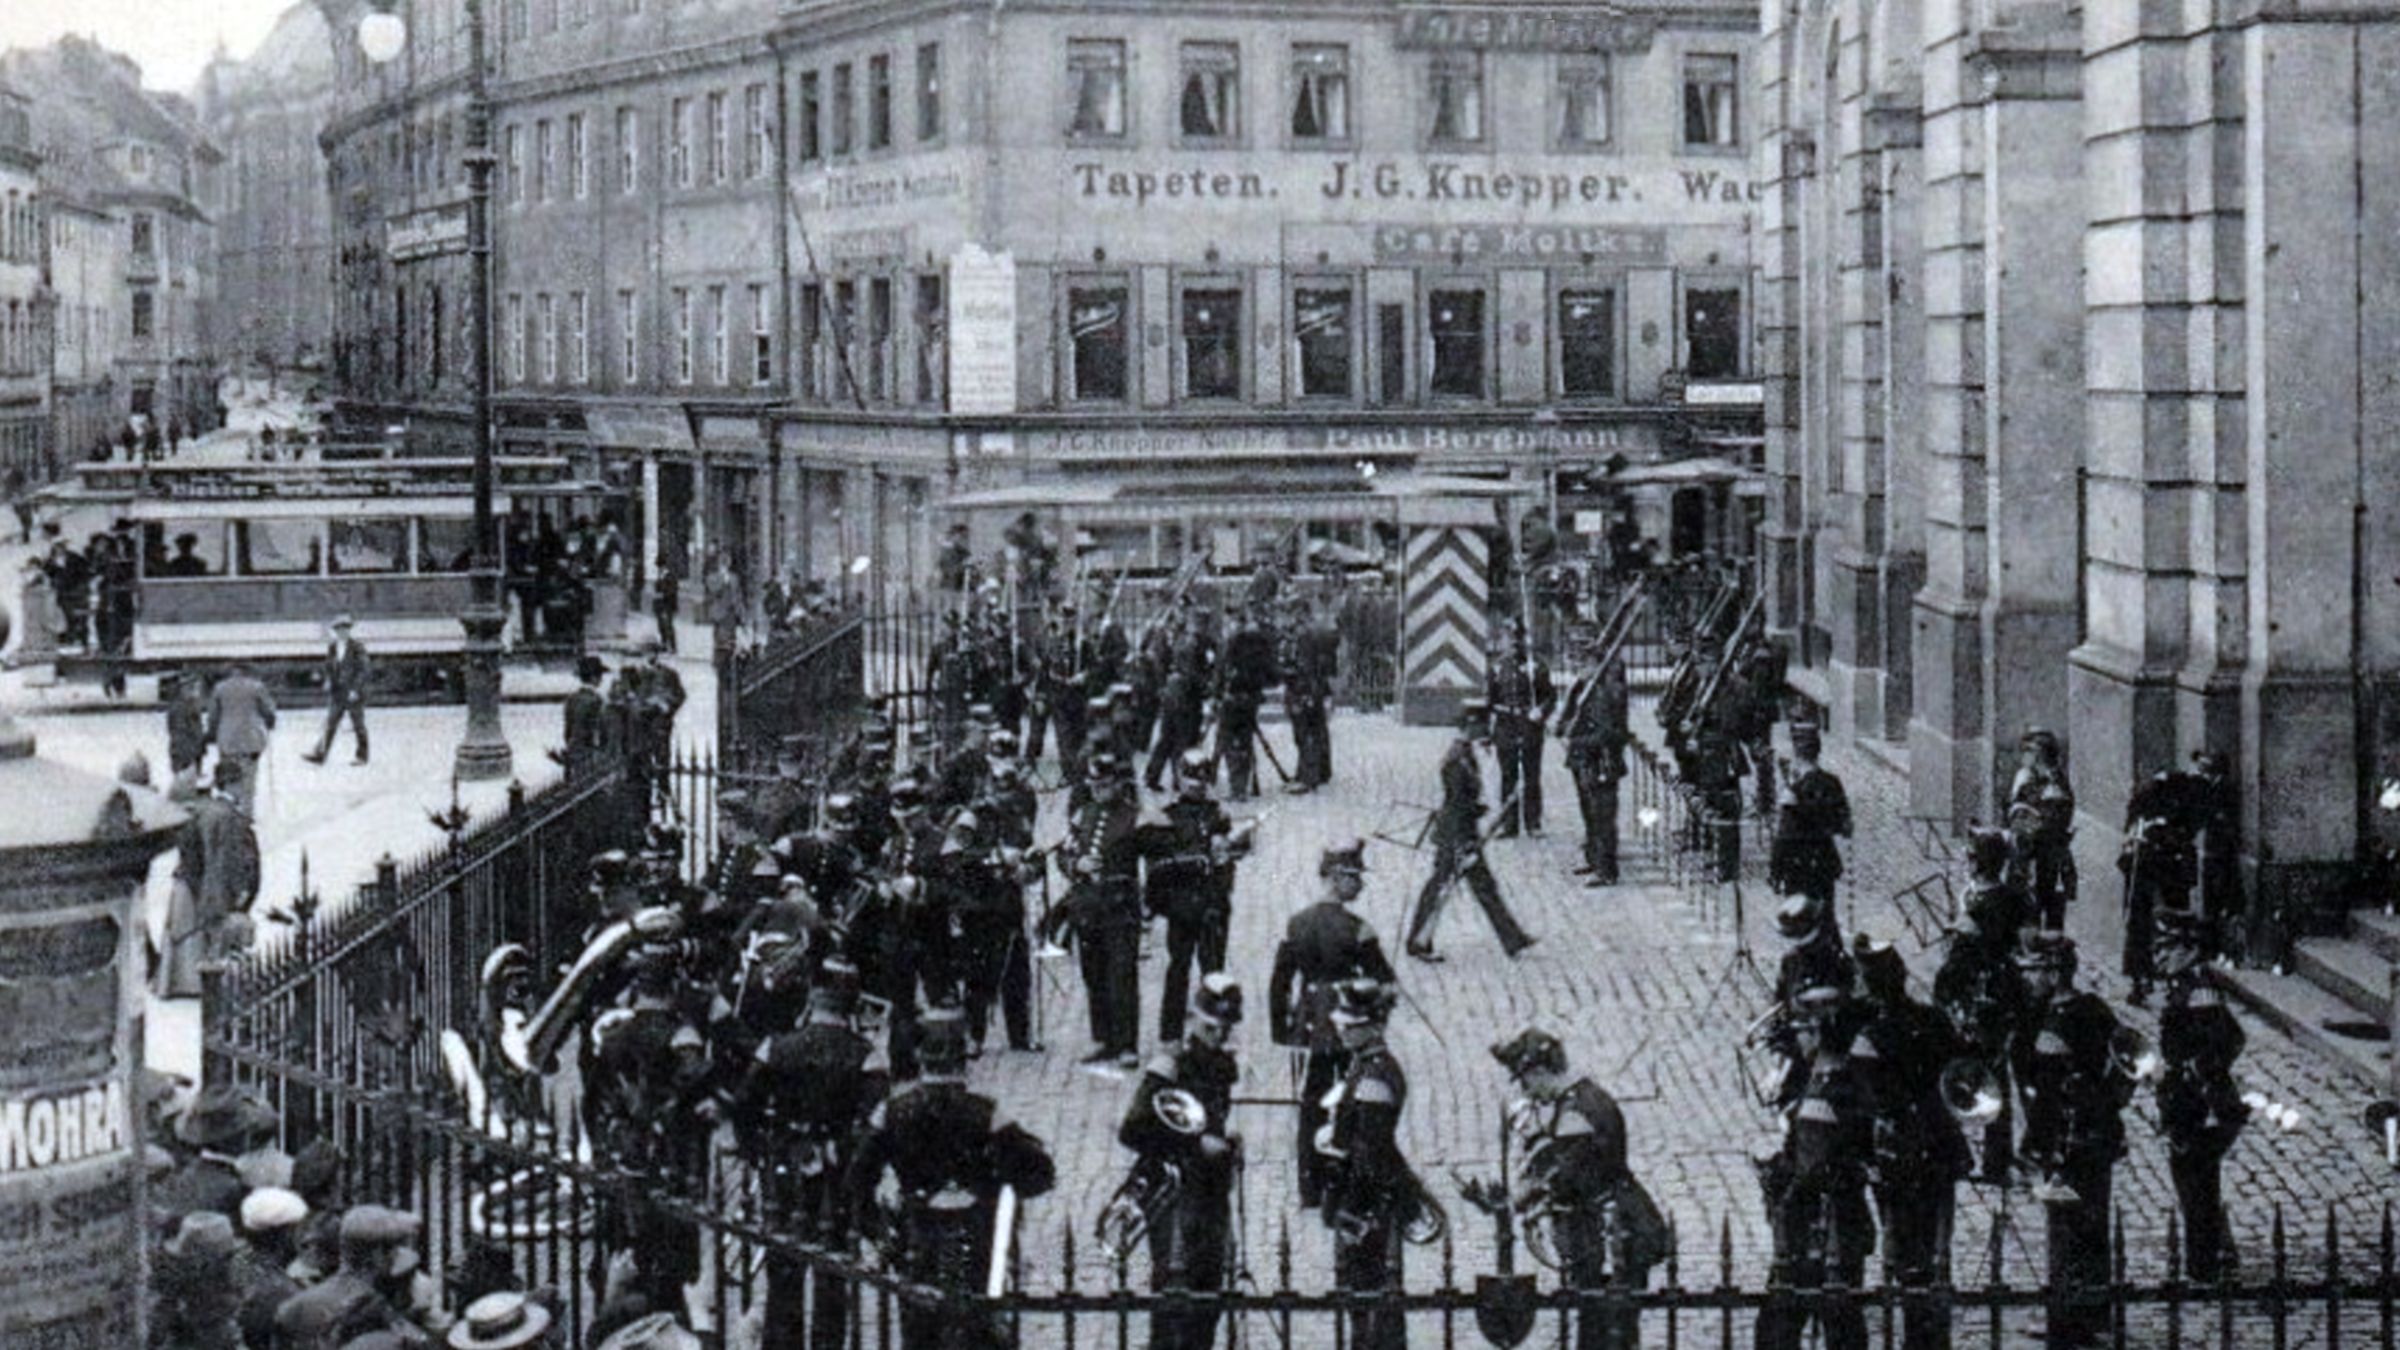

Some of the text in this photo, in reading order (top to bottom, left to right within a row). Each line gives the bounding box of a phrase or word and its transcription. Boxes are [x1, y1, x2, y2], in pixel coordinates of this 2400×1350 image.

[1073, 163, 1279, 207] Tapeten.
[1326, 426, 1619, 451] Paul Bergmann
